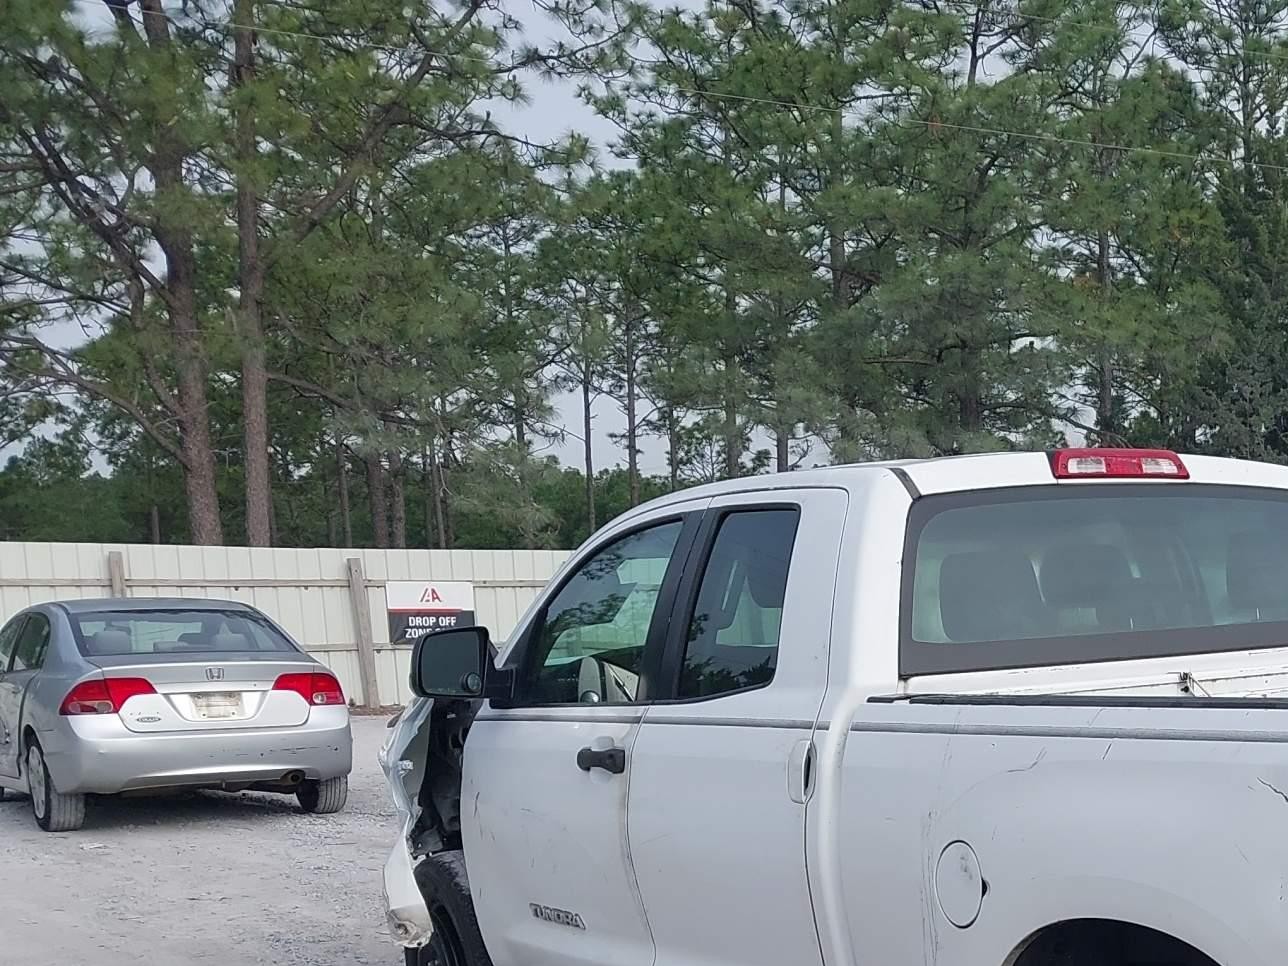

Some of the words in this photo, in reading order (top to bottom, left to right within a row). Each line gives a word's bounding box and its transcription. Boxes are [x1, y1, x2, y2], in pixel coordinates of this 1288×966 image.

[408, 616, 437, 627] DROP
[438, 616, 457, 626] OFF
[528, 902, 587, 931] TUNDRA
